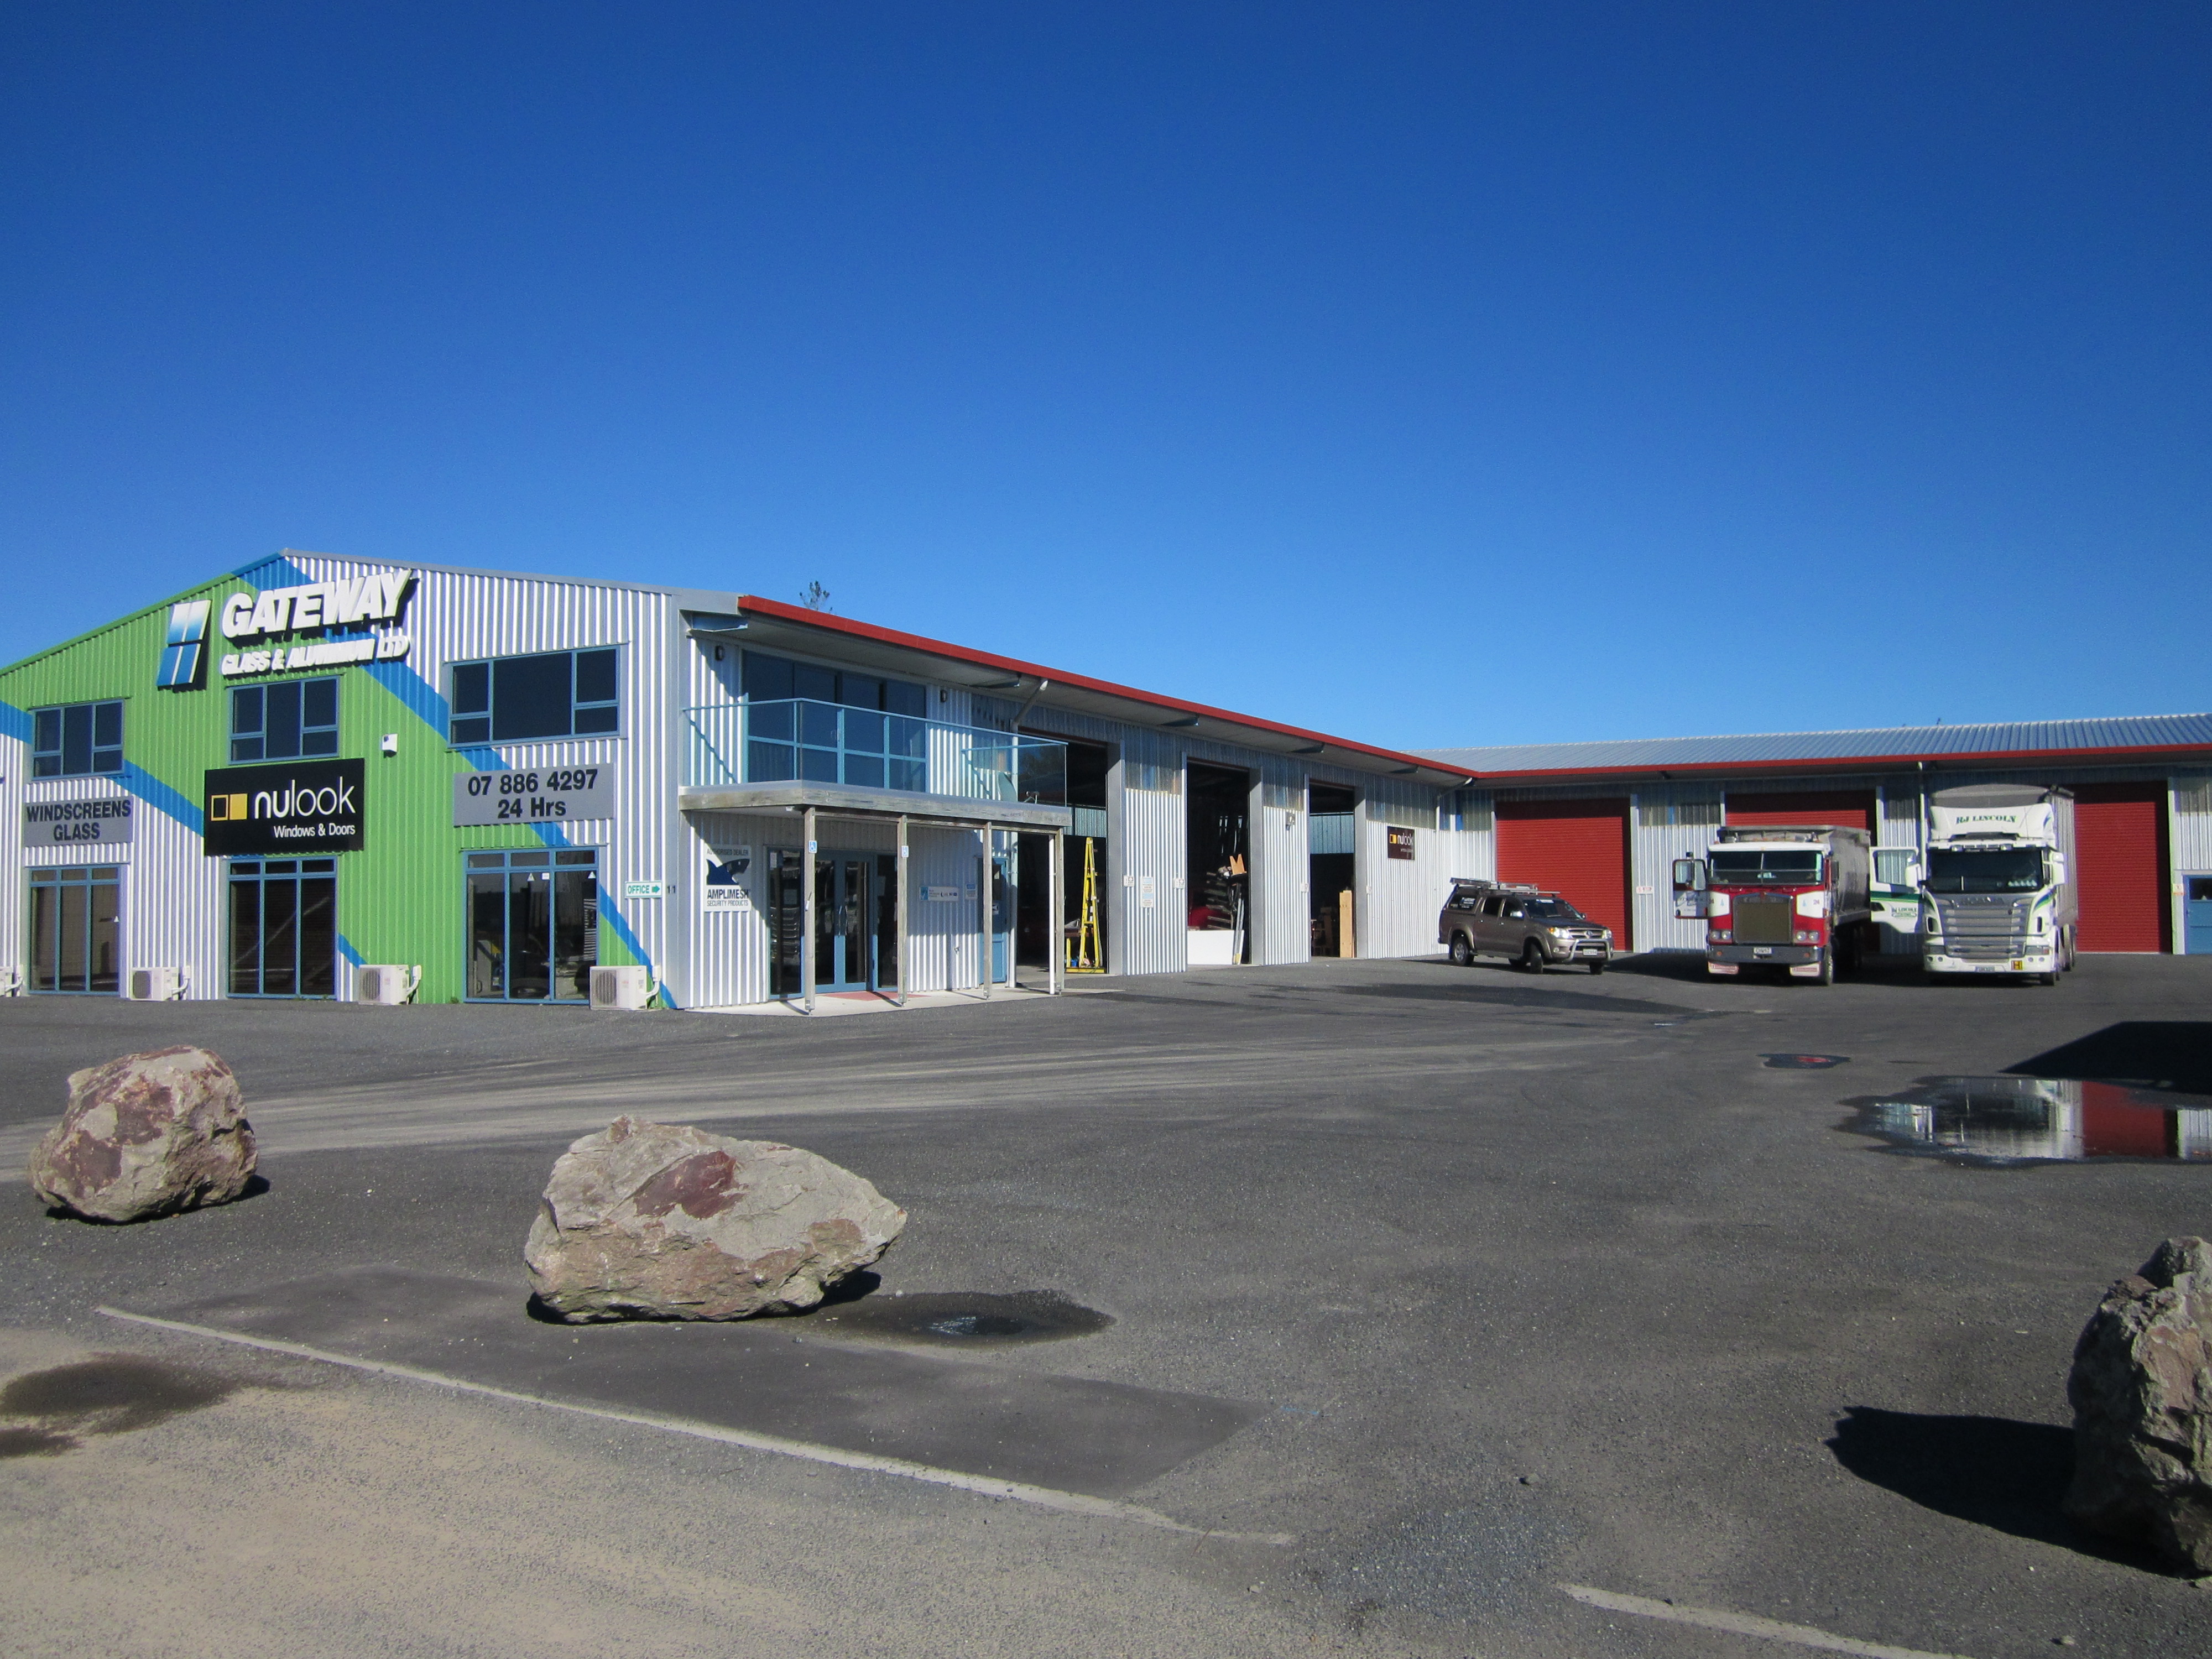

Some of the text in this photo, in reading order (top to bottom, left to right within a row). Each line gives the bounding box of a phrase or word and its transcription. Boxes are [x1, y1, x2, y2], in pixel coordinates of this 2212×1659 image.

[222, 568, 411, 638] GATEWAY
[222, 636, 410, 675] GLASS & ALUMINIUM LTD
[468, 769, 598, 796] 07 886 4297
[254, 776, 356, 819] nulook
[498, 797, 566, 818] 24 Hrs
[27, 800, 131, 822] WINDSCREENS
[1972, 815, 2016, 823] LINCOLN
[54, 822, 100, 841] GLASS
[274, 822, 356, 838] Windows & Doors
[628, 885, 650, 894] OFFICE
[707, 889, 749, 899] AMPLIMESH
